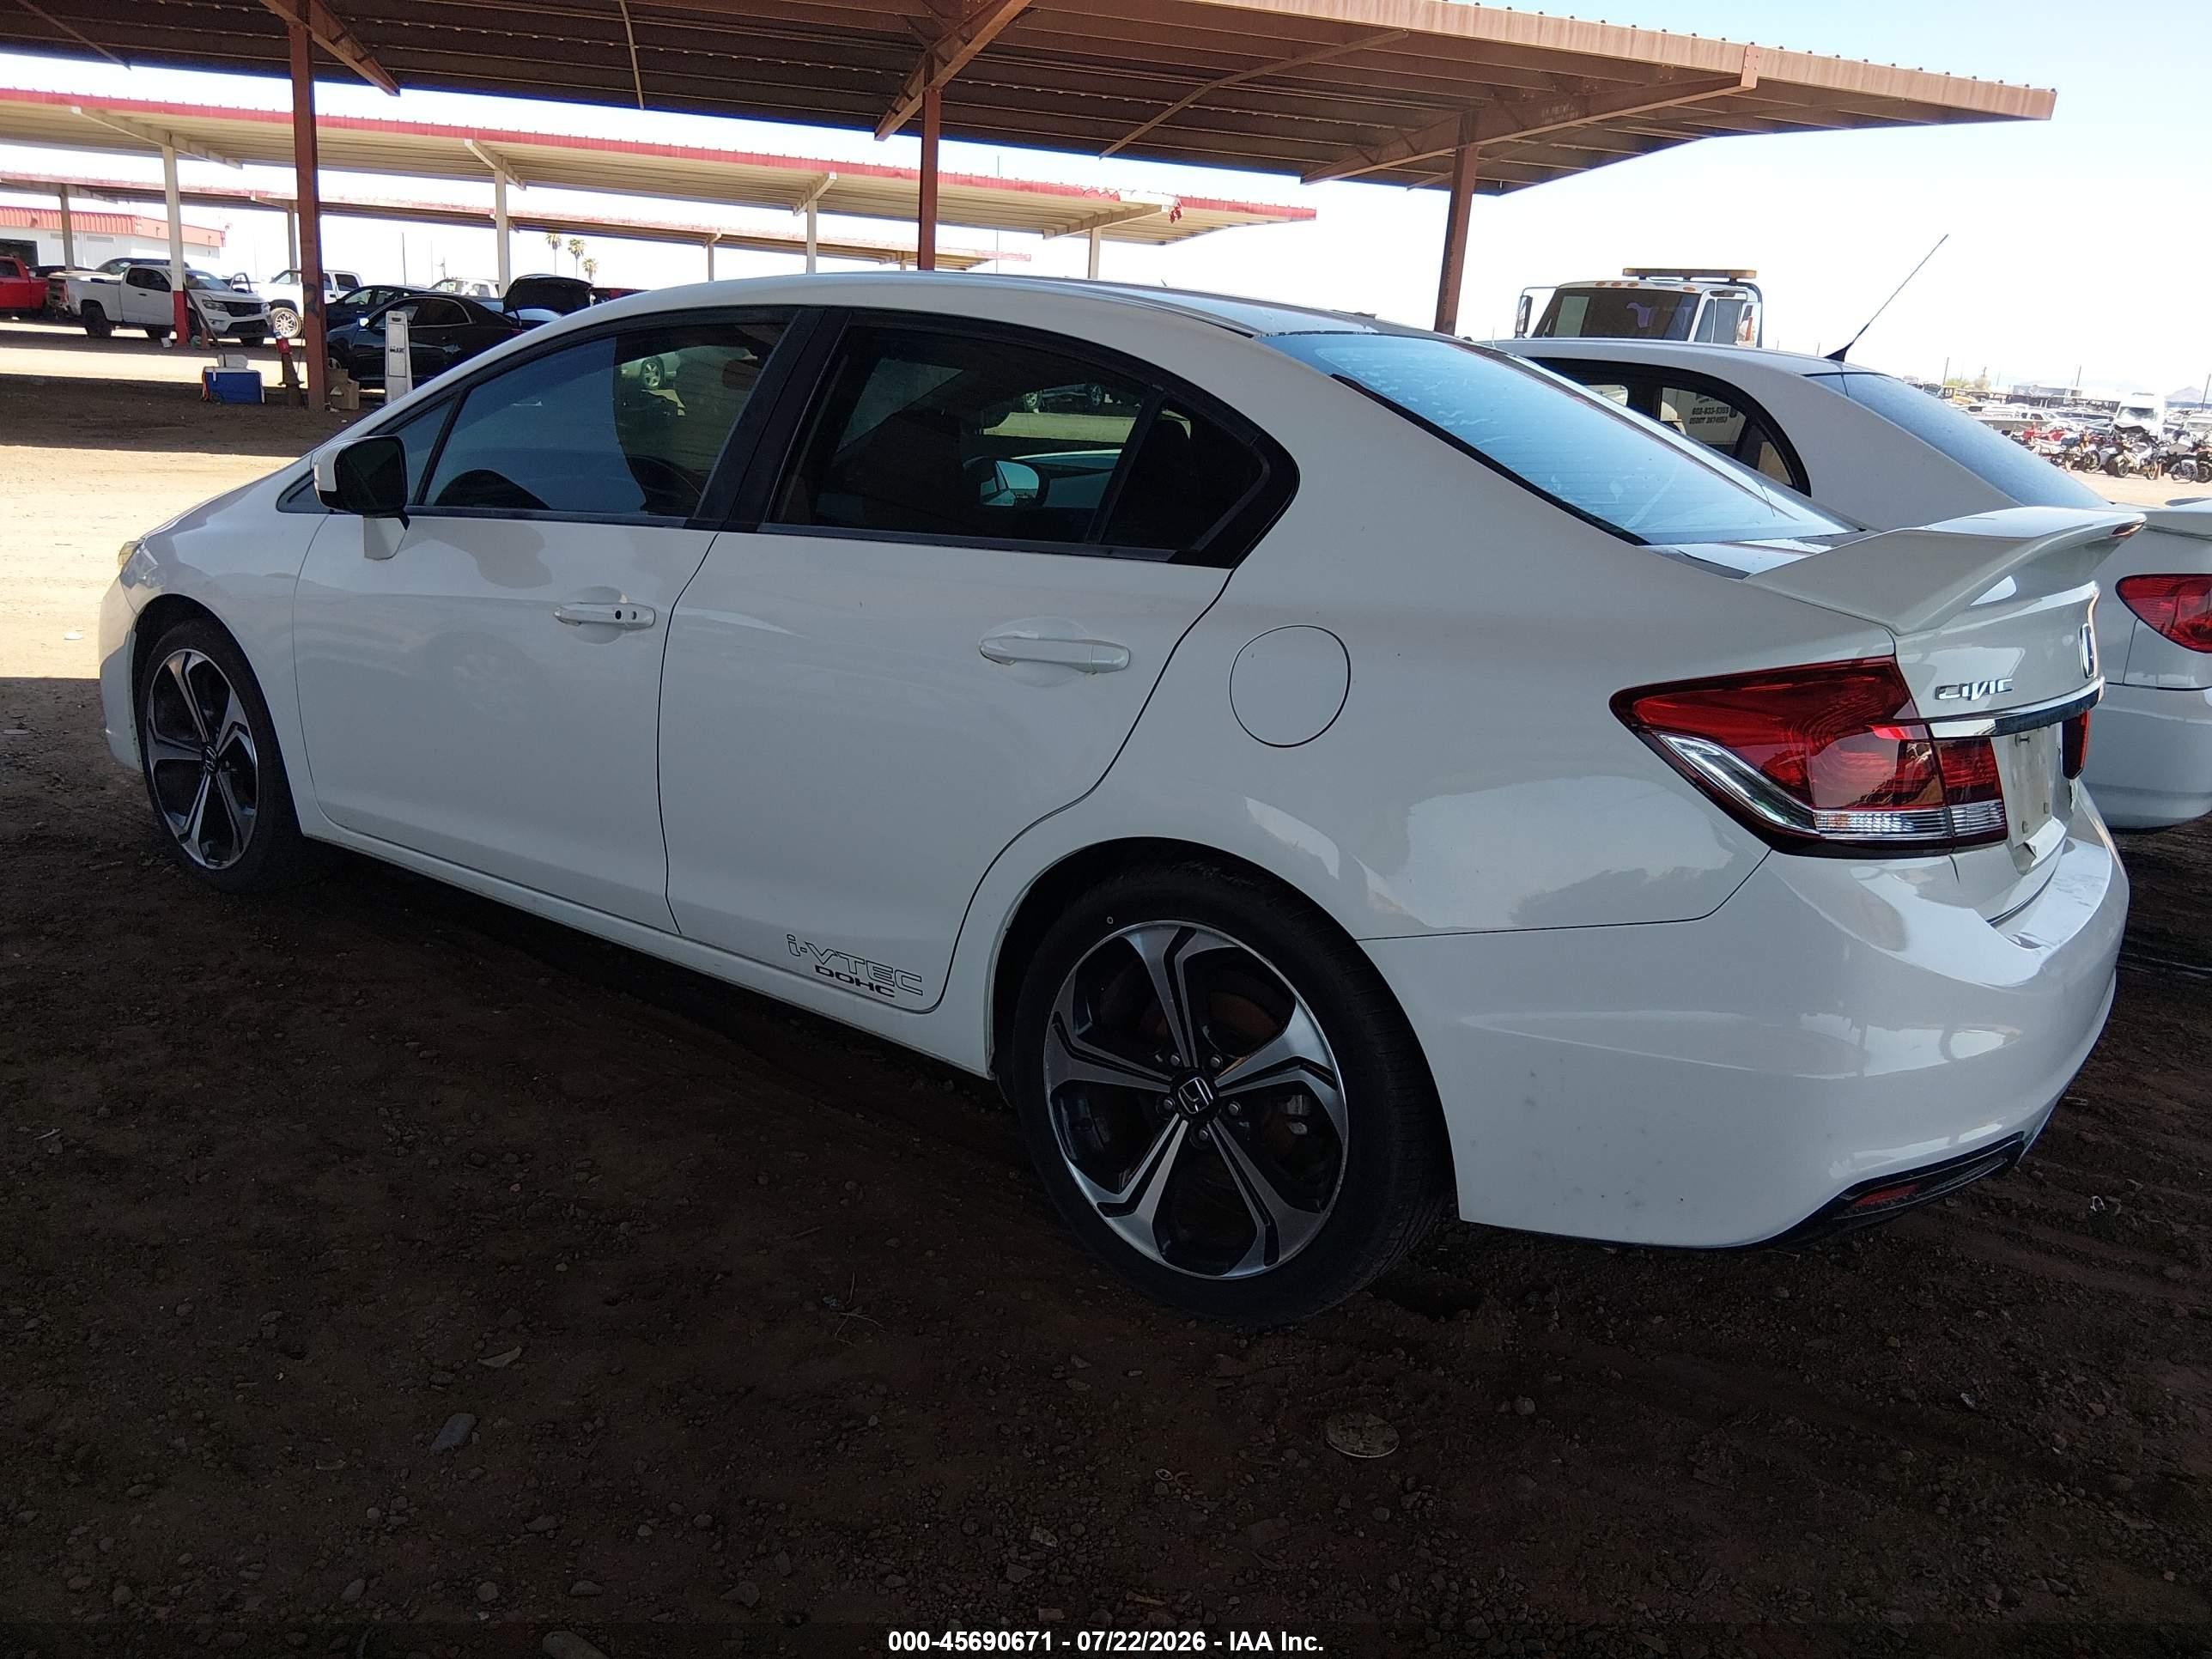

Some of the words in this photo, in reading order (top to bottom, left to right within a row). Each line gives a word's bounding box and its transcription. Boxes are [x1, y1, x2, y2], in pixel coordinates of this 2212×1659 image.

[1935, 678, 2013, 700] CIVIC
[787, 934, 923, 996] i-VTEC
[815, 965, 896, 998] DOHC
